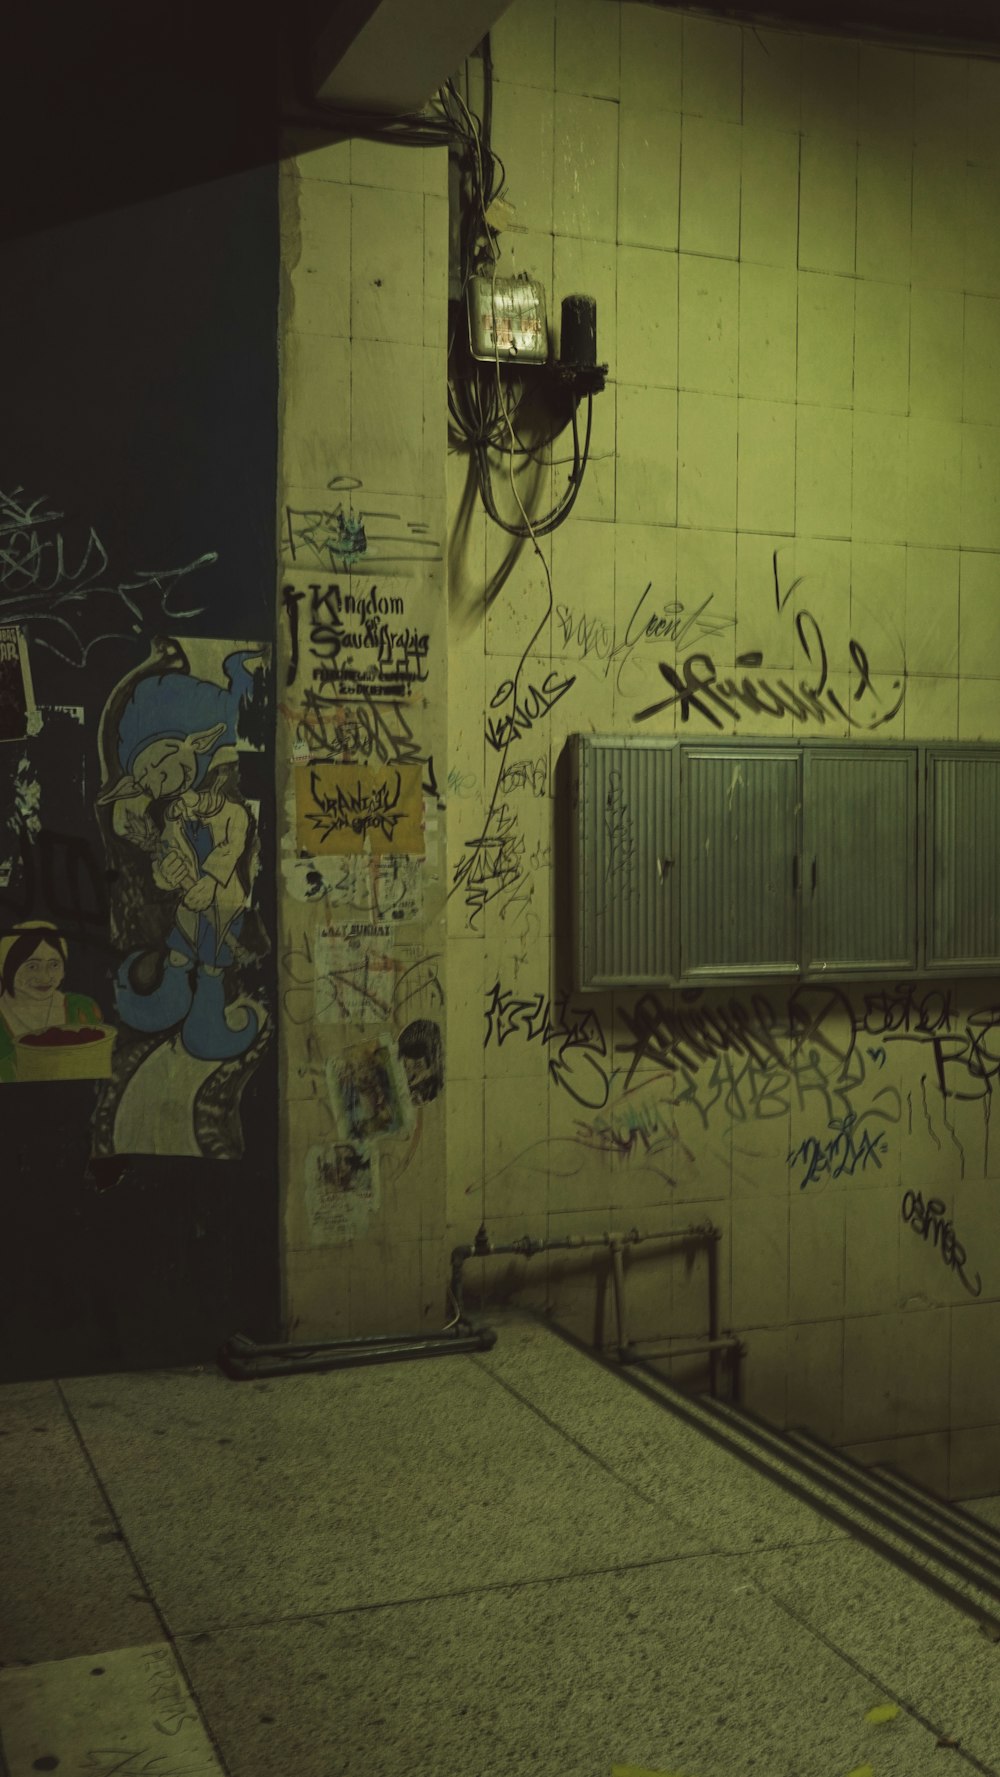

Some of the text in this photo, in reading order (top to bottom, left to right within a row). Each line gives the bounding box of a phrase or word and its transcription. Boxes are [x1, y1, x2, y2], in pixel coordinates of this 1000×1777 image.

[309, 584, 403, 626] Kingdom
[309, 623, 430, 661] Saudi Arabia
